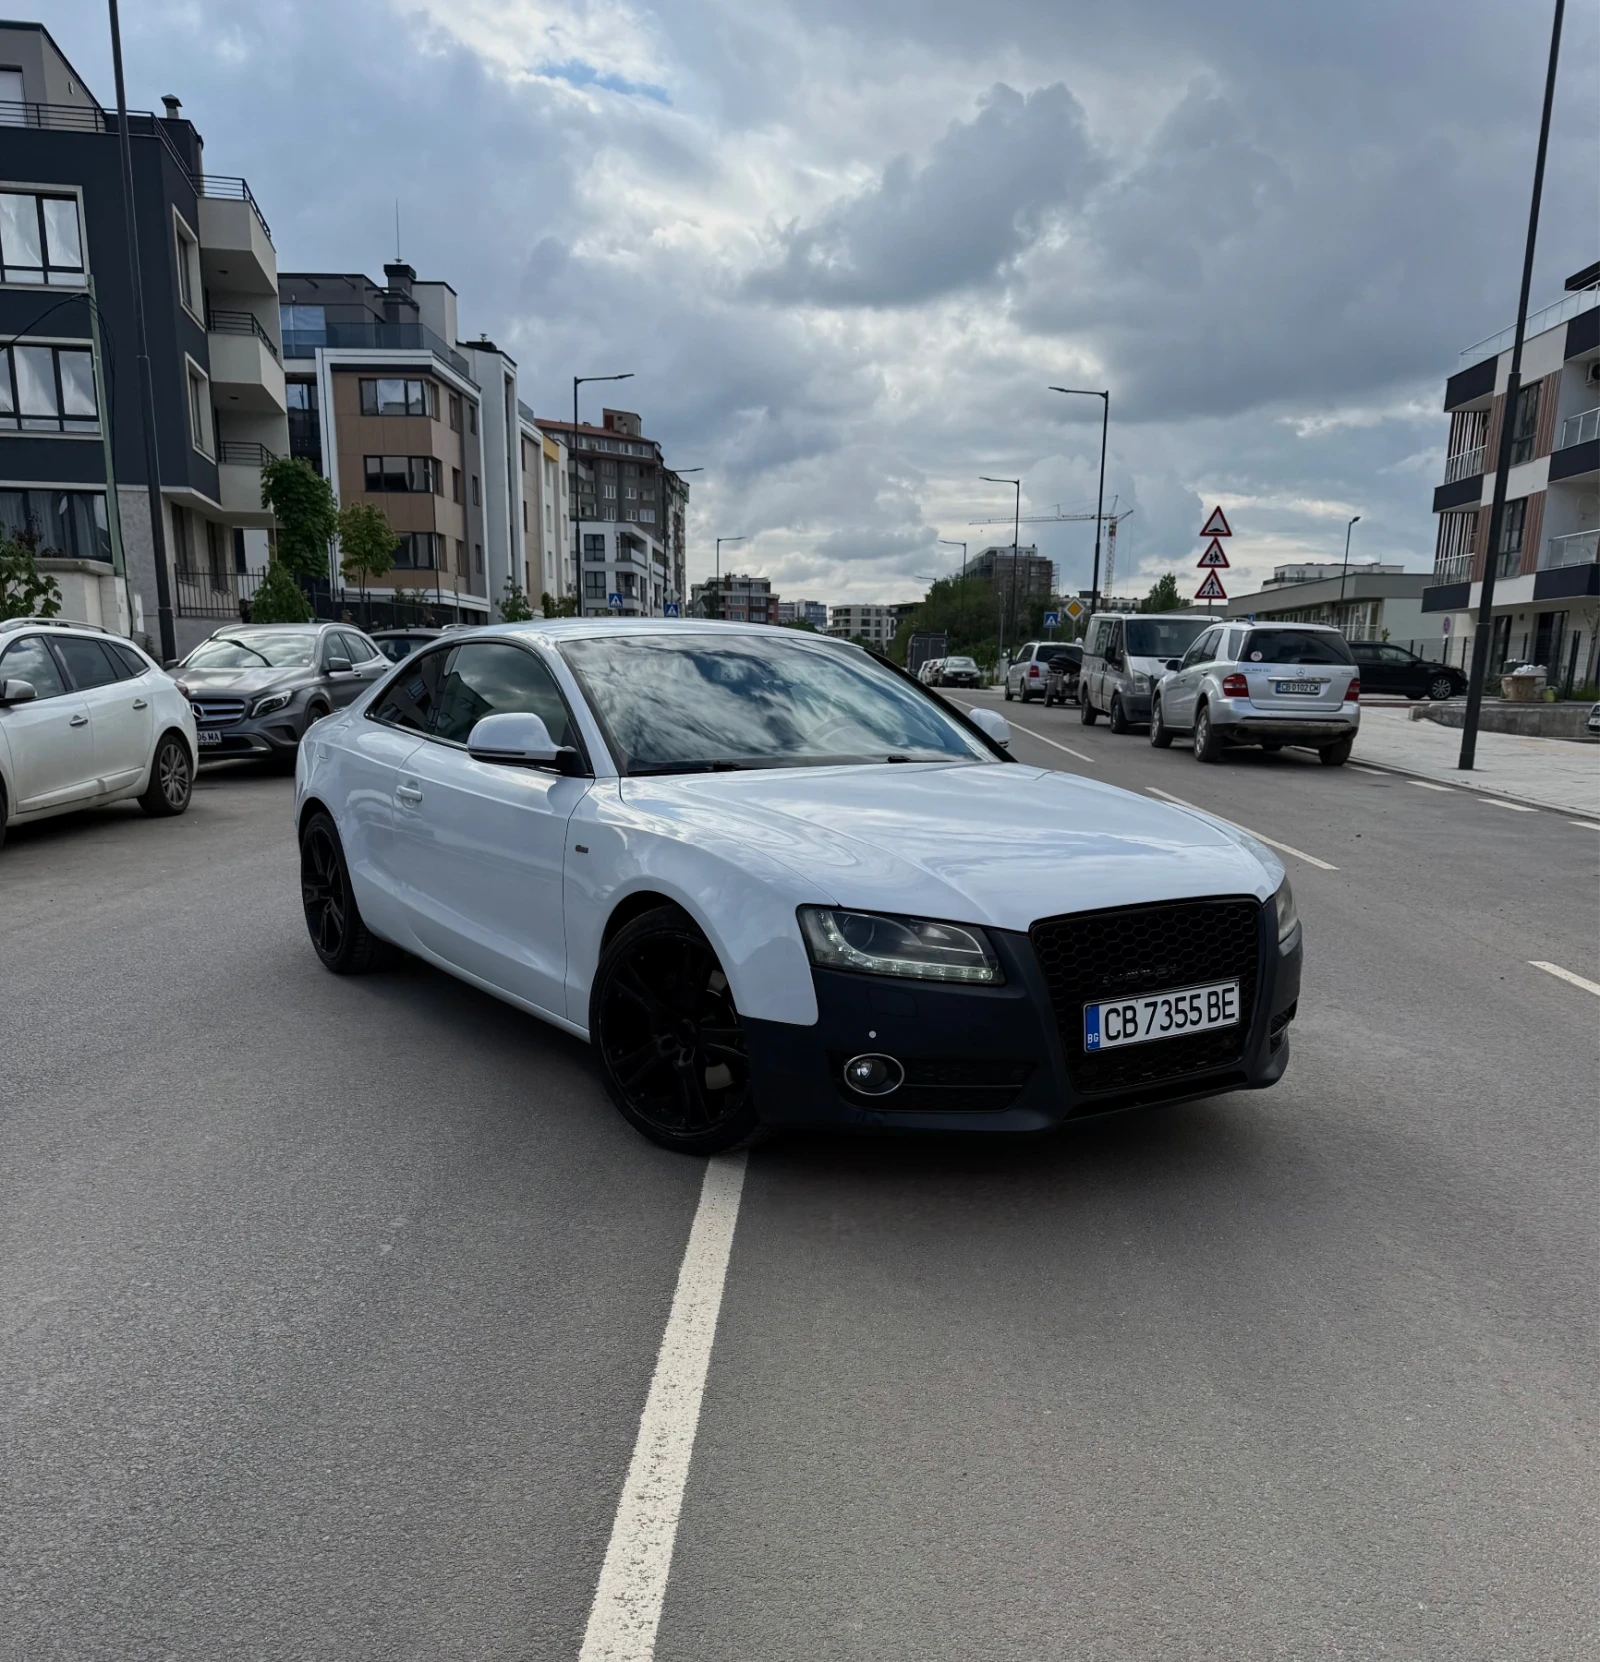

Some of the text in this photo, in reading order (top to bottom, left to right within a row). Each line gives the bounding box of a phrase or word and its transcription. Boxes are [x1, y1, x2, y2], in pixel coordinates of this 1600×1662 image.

[1104, 987, 1236, 1041] CB 7355 BE
[1087, 1032, 1099, 1044] BG
